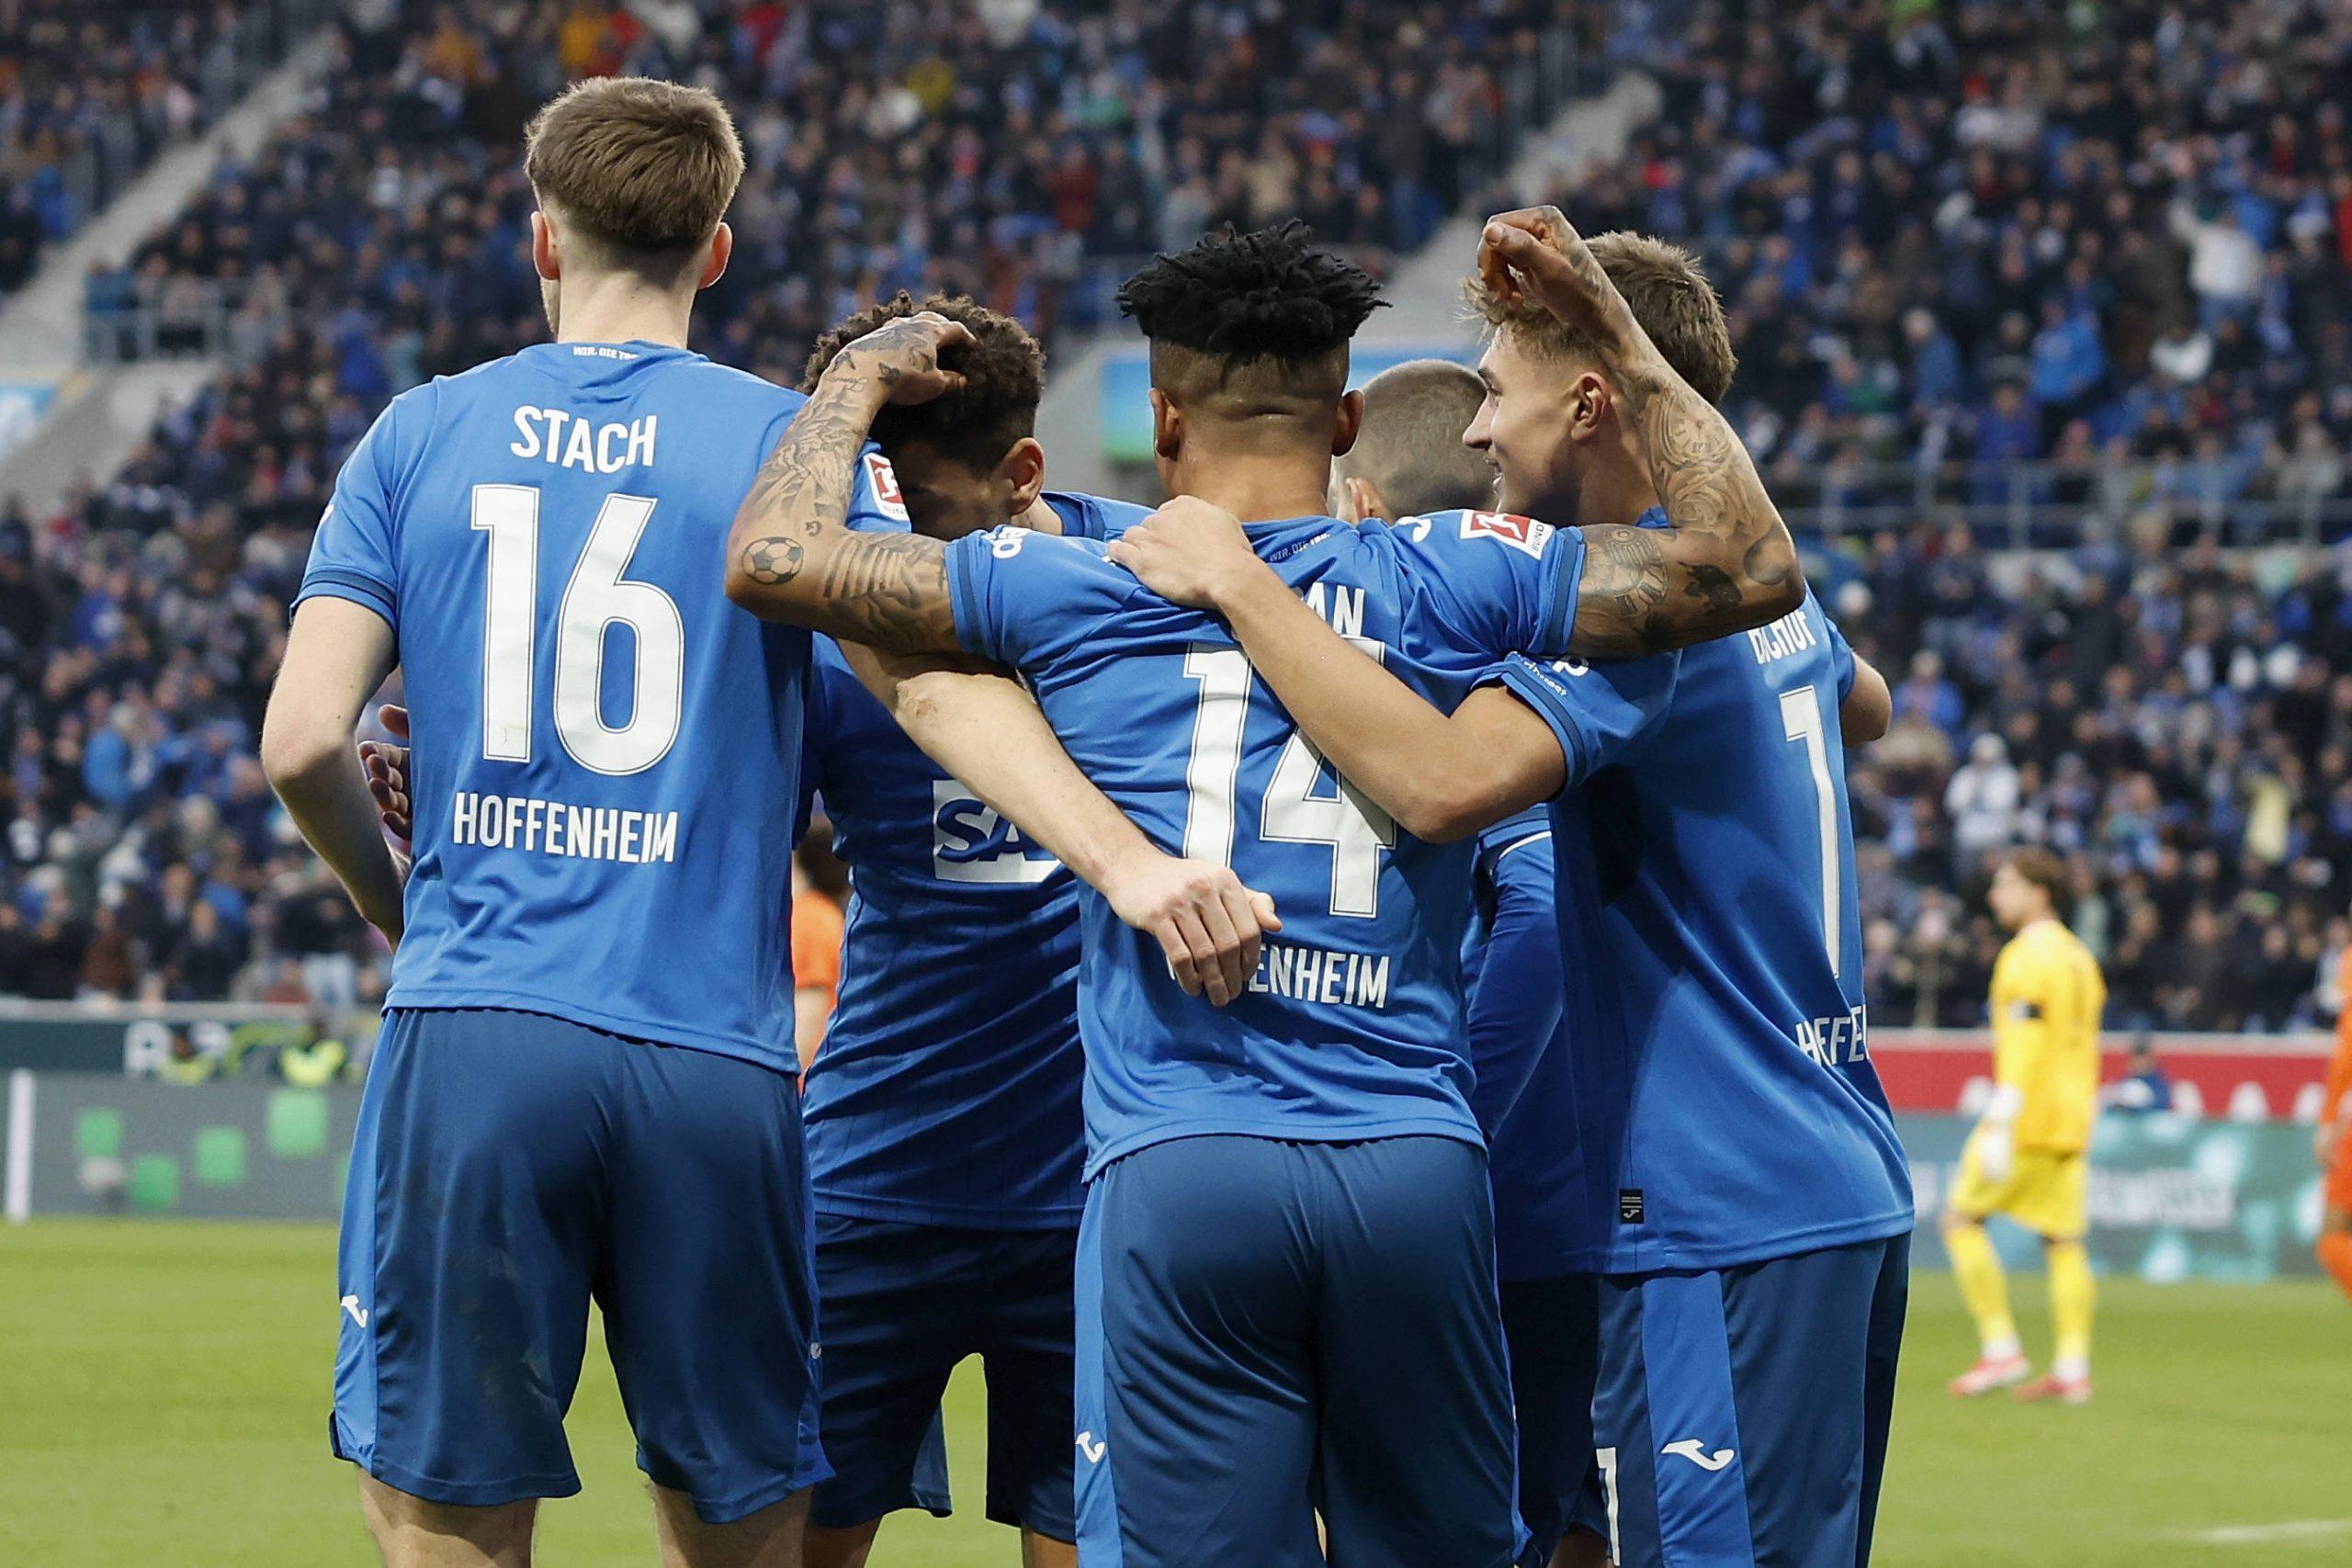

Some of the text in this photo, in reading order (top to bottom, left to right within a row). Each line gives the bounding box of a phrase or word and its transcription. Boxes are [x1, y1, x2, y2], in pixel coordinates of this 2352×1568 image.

[510, 405, 657, 473] STACH
[470, 483, 684, 776] 16
[1289, 581, 1365, 636] AN
[1183, 635, 1396, 919] 14
[453, 792, 678, 863] HOFFENHEIM
[937, 798, 1058, 863] SA
[1166, 942, 1389, 1009] ENHEIM
